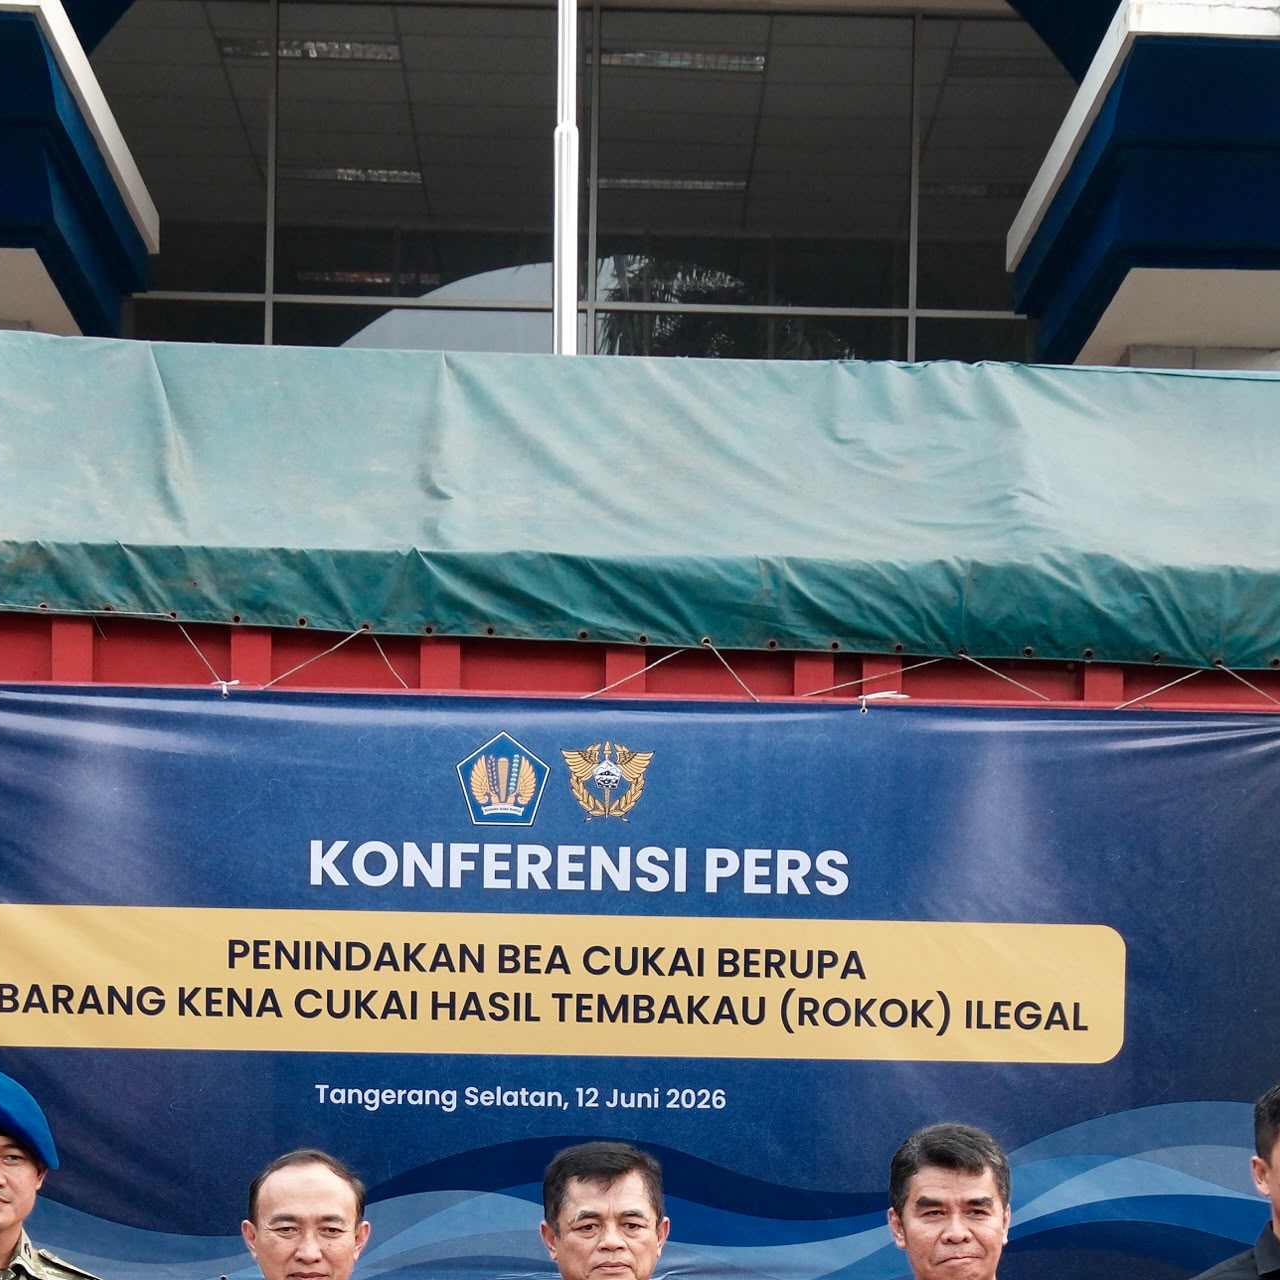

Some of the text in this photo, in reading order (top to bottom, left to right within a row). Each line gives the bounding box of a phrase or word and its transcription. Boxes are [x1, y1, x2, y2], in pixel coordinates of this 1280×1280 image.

[311, 840, 848, 895] KONFERENSI PERS
[229, 940, 866, 979] PENINDAKAN BEA CUKAI BERUPA
[179, 987, 282, 1017] KENA
[295, 989, 417, 1020] CUKAI
[432, 991, 540, 1021] HASIL
[552, 993, 765, 1025] TEMBAKAU
[781, 991, 950, 1036] (ROKOK)
[966, 1001, 1088, 1030] ILEGAL
[315, 1085, 726, 1112] Tangerang Selatan, 12 Juni 2026
